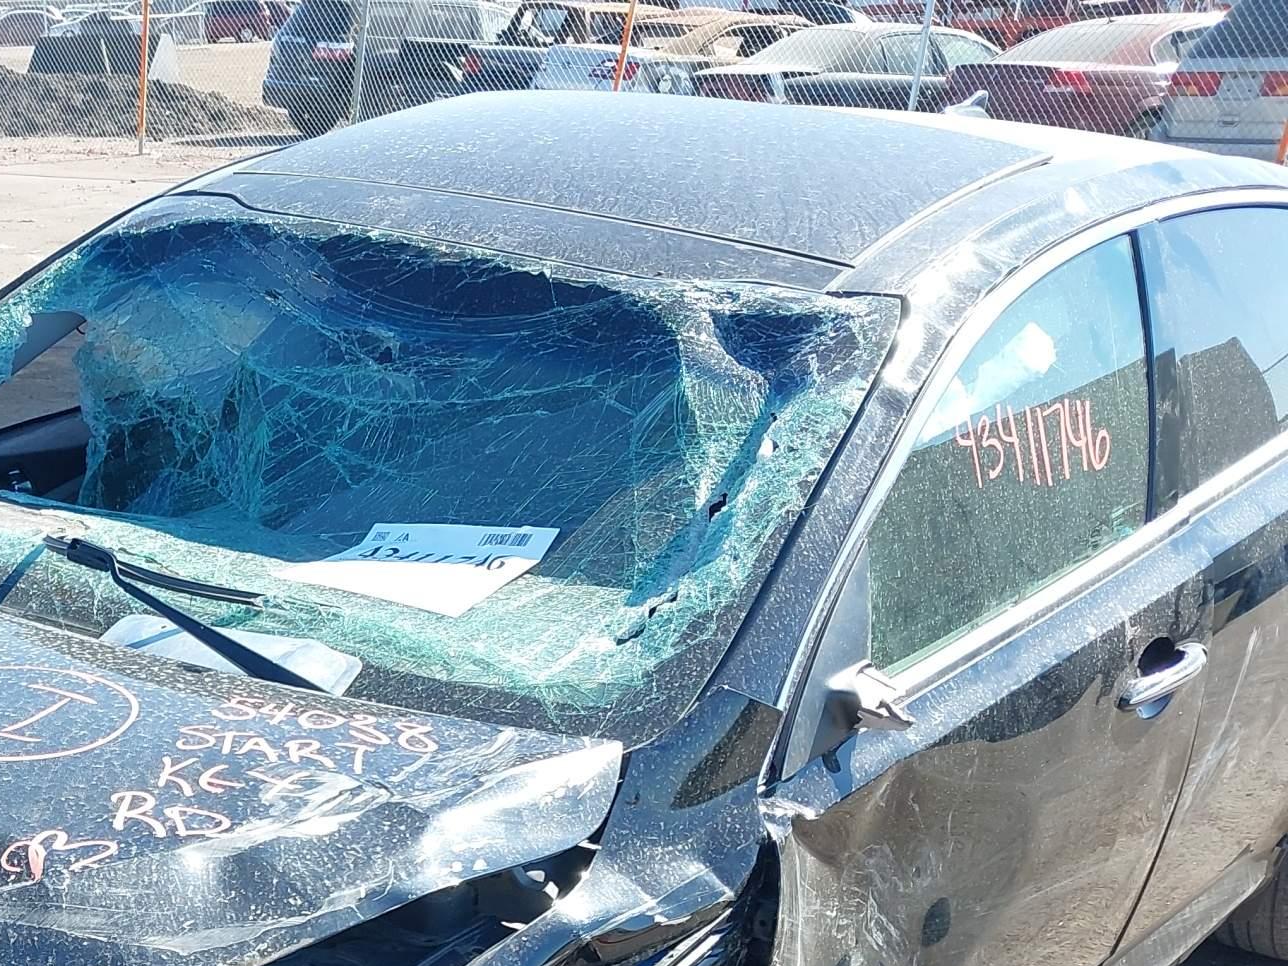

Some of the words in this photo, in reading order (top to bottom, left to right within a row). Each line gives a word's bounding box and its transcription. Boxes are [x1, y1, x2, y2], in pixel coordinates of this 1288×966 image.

[955, 398, 1111, 489] 43411746
[175, 723, 377, 775] START
[211, 697, 438, 752] 54038
[112, 790, 232, 838] RD
